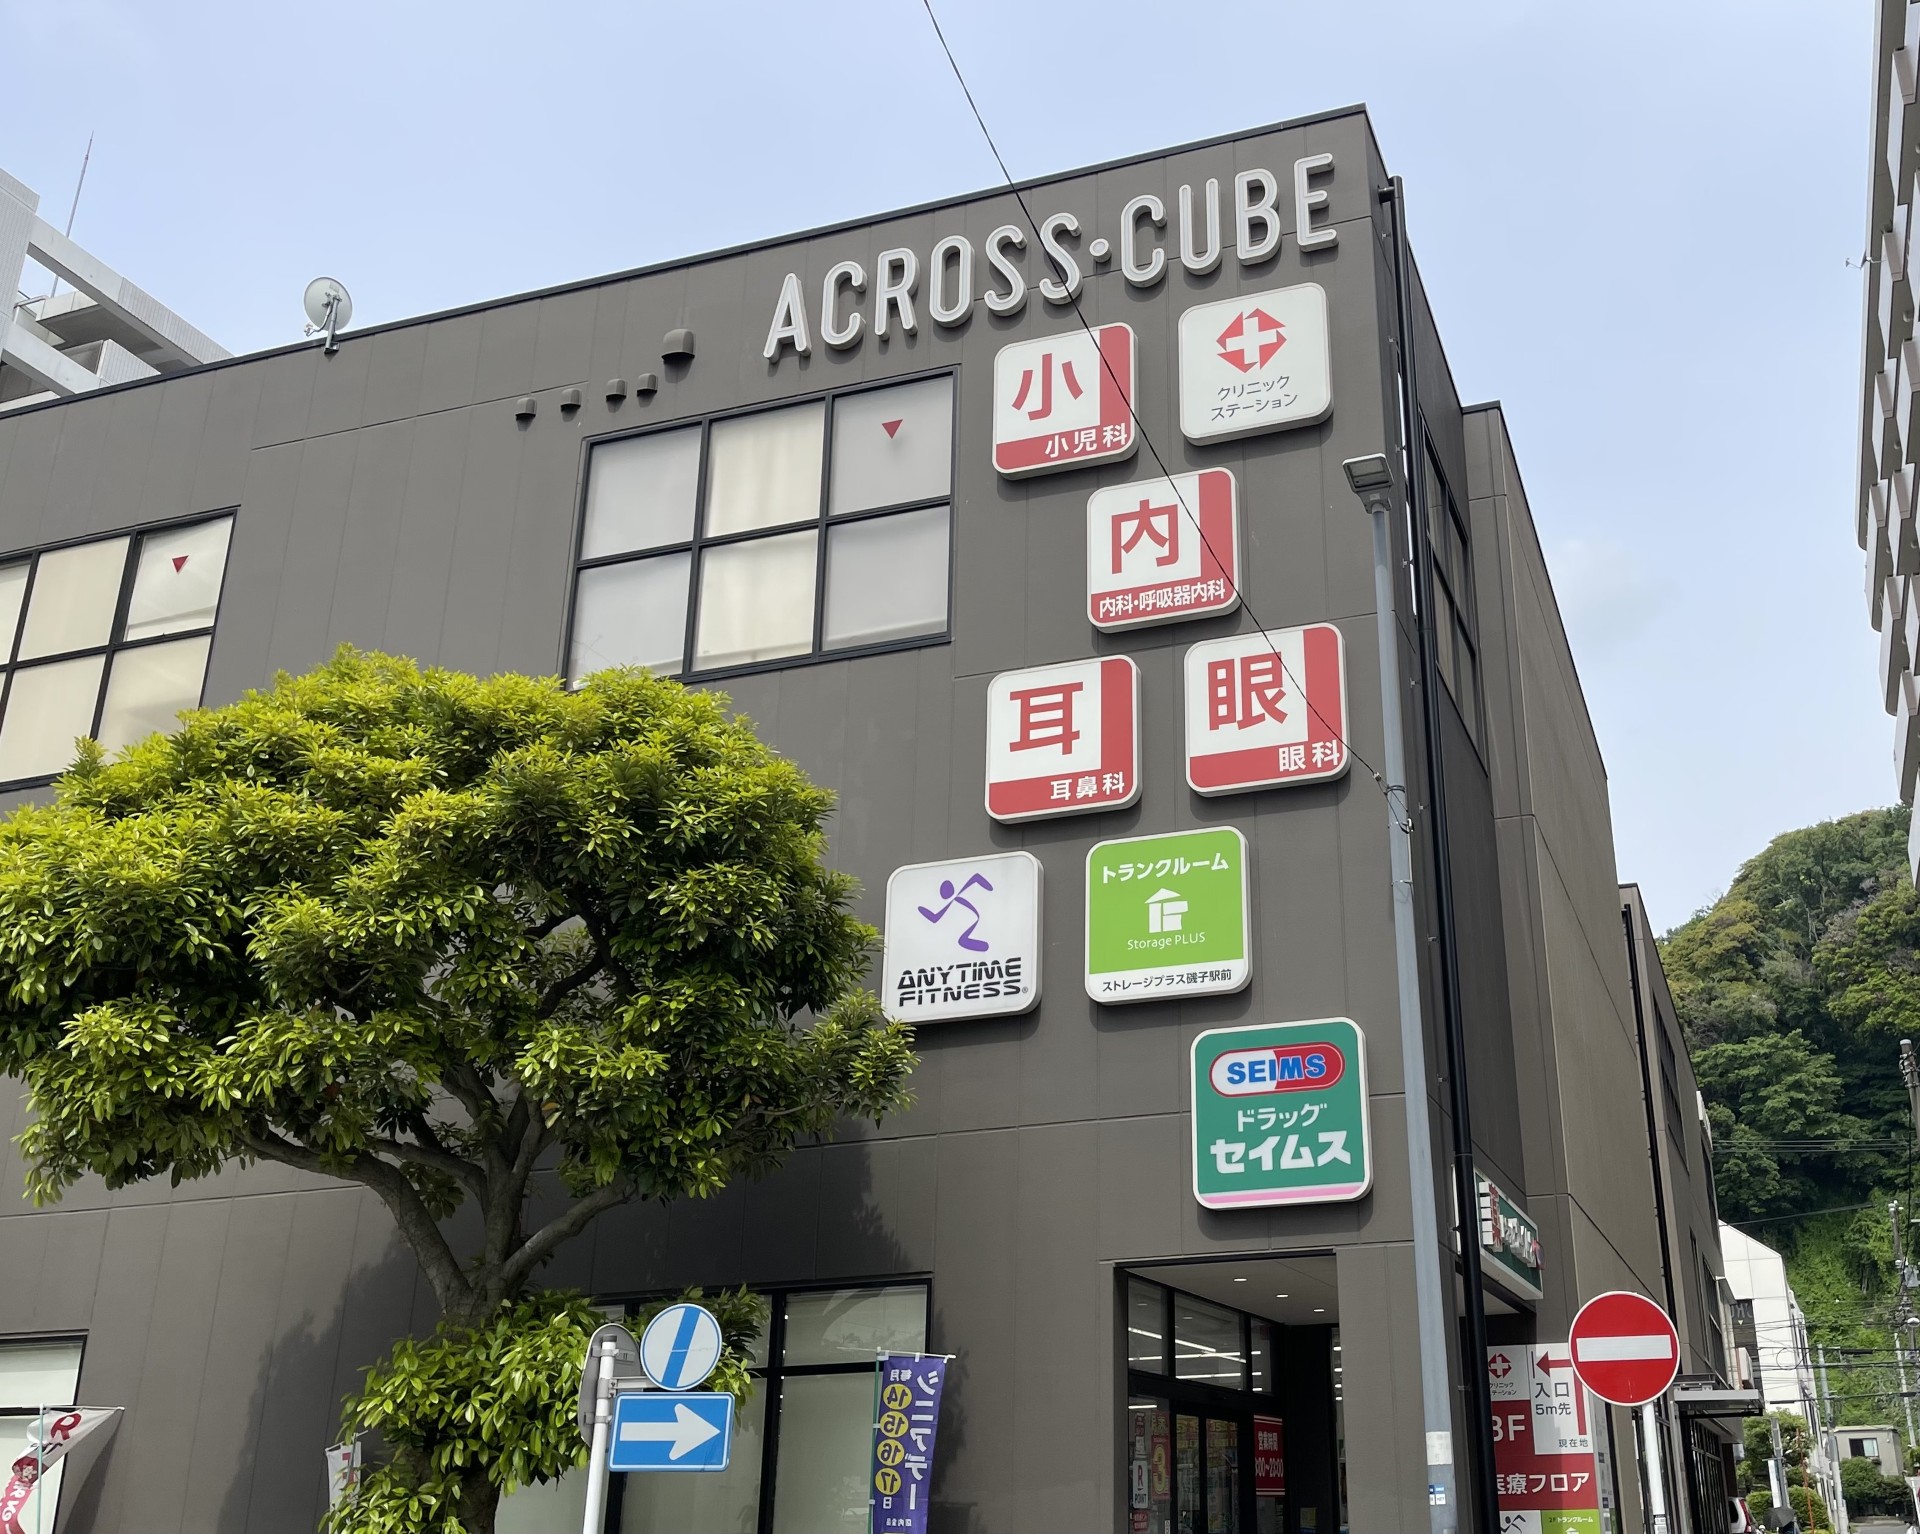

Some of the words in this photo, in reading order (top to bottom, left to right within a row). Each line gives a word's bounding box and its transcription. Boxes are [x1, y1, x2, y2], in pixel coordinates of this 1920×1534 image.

[1011, 353, 1084, 421] 小
[1217, 375, 1290, 400] クリニック
[1211, 392, 1298, 421] ステーション
[1044, 423, 1128, 460] 小児科
[1111, 499, 1179, 575] 内
[1099, 578, 1226, 619] 内科・呼吸器内科
[1207, 650, 1288, 731] 眼
[1009, 681, 1084, 756] 耳
[1278, 740, 1340, 772] 眼科
[1050, 772, 1125, 802] 耳鼻科
[1101, 851, 1230, 884] トランクルーム
[1127, 937, 1172, 951] Storage
[1174, 931, 1206, 945] PLUS
[897, 956, 1022, 990] ANYTIME
[1102, 968, 1232, 993] ストレージプラス磯子駅前
[1226, 1053, 1327, 1084] SEIMS
[1236, 1102, 1329, 1133] ドラッグ
[1209, 1129, 1352, 1175] セイムス
[1534, 1382, 1570, 1399] 入口
[1535, 1403, 1572, 1416] 5m先
[1558, 1438, 1589, 1448] 現在地
